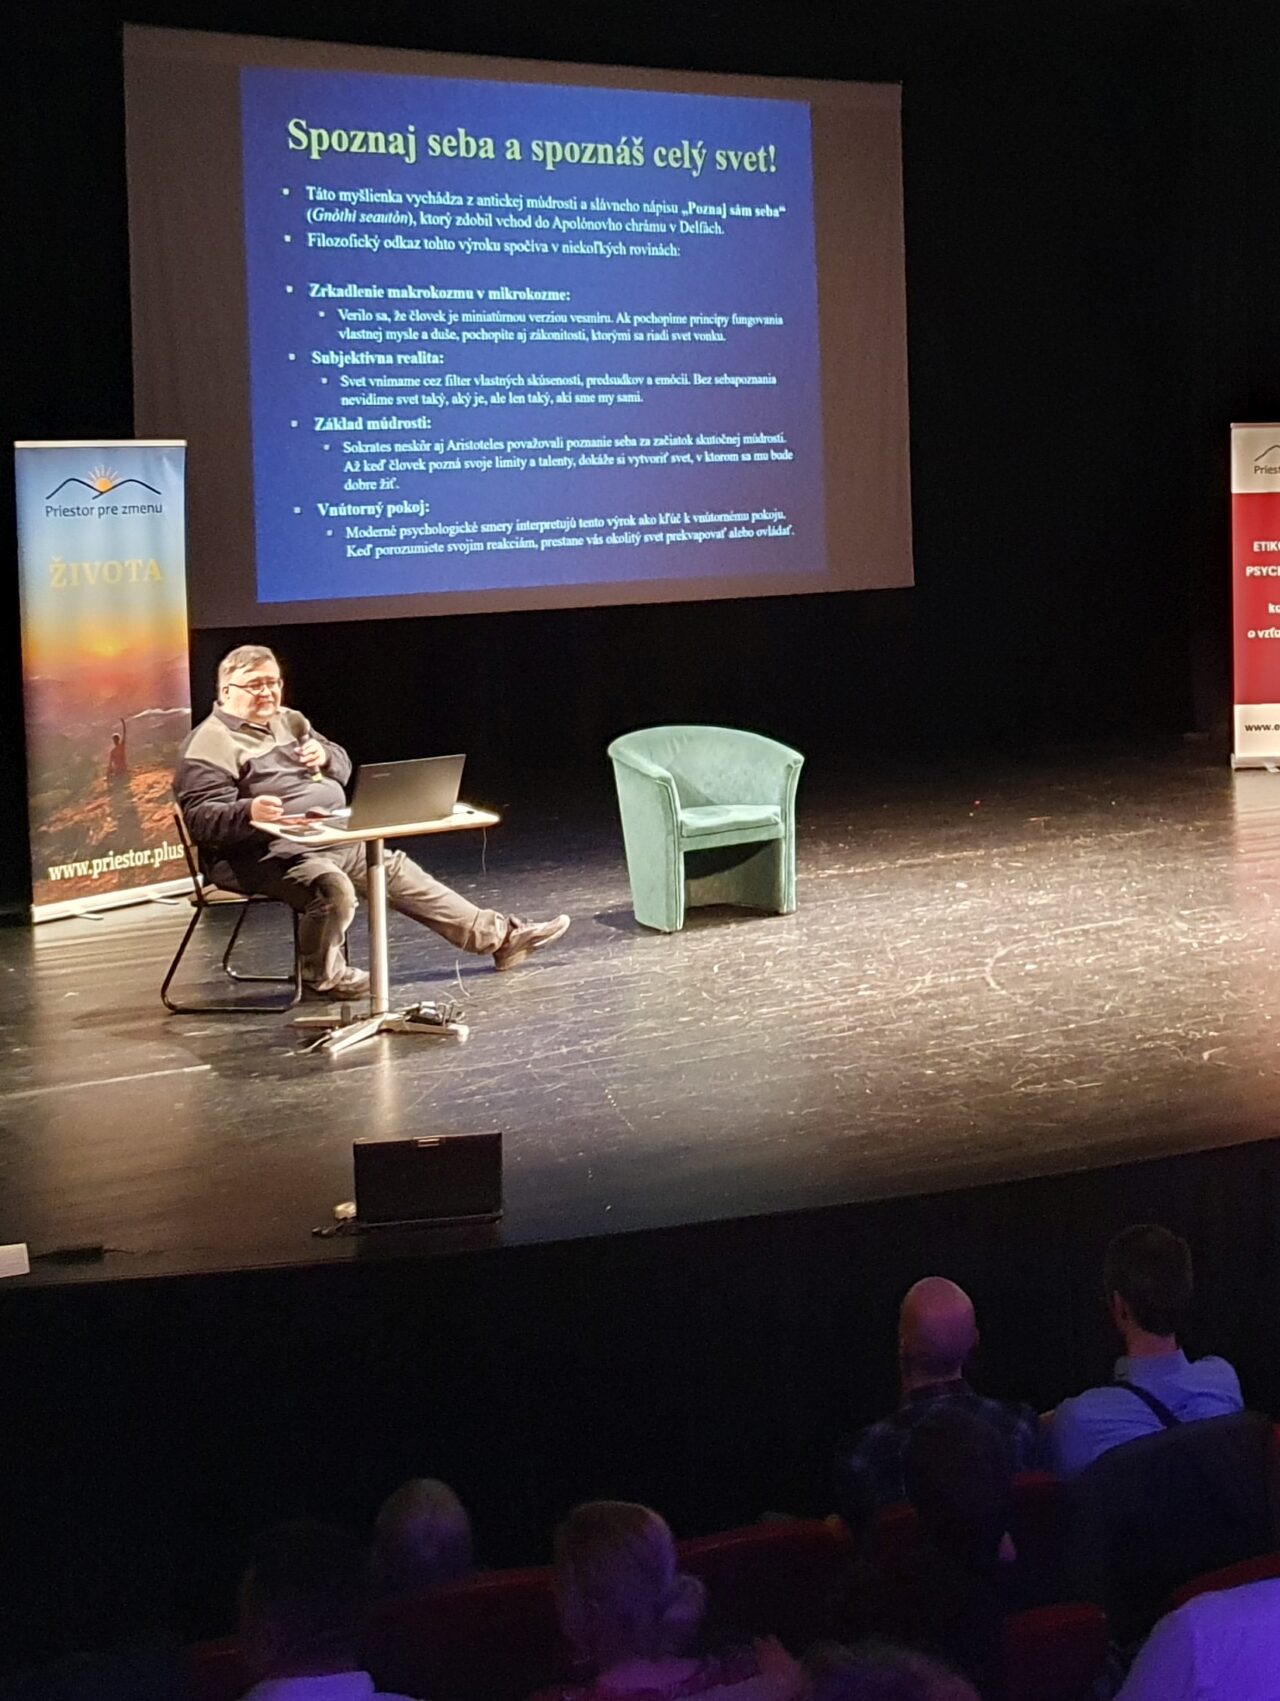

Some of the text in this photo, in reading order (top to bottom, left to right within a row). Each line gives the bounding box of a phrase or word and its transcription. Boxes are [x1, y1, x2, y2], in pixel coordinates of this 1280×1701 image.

[286, 117, 777, 178] Spoznaj seba a spoznáš celý svet!
[304, 184, 336, 201] Táto
[337, 187, 404, 206] myšlienka
[405, 189, 464, 208] vychádza
[466, 195, 474, 206] z
[475, 192, 524, 212] antickej
[525, 194, 578, 210] múdrosti
[579, 200, 588, 210] a
[589, 196, 640, 212] slávneho
[642, 199, 679, 217] nápisu
[728, 203, 753, 217] sám
[418, 210, 452, 230] ktorý
[454, 212, 493, 227] zdobil
[495, 213, 532, 228] vchod
[534, 214, 550, 229] do
[551, 215, 623, 233] Apolónovho
[624, 217, 667, 233] chrámu
[668, 222, 676, 233] v
[678, 219, 725, 235] Delfách.
[306, 231, 681, 258] Filozofický odkaz tohto výroku spočíva v niekoľkých rovinách:
[308, 282, 571, 301] Zrkadlenie makrokozmu v mikrokozme:
[336, 307, 374, 322] Verilo
[393, 309, 407, 322] že
[408, 308, 446, 322] človek
[447, 309, 459, 326] je
[528, 310, 568, 323] verziou
[615, 311, 632, 324] Ak
[337, 326, 383, 343] vlastnej
[384, 326, 420, 343] mysle
[420, 330, 429, 340] a
[516, 327, 527, 344] aj
[590, 328, 632, 344] ktorými
[632, 332, 645, 341] sa
[645, 328, 670, 341] riadi
[670, 330, 692, 341] svet
[310, 349, 444, 368] Subjektívna realita:
[339, 374, 367, 388] Svet
[422, 377, 442, 387] cez
[444, 373, 472, 387] filter
[473, 373, 525, 390] vlastných
[692, 372, 712, 385] Bez
[395, 393, 420, 405] svet
[450, 391, 472, 408] aký
[489, 390, 507, 404] ale
[508, 390, 526, 404] len
[574, 393, 596, 403] sme
[597, 393, 615, 406] my
[313, 416, 364, 431] Základ
[342, 439, 392, 454] Sokrates
[433, 438, 444, 455] aj
[446, 437, 505, 452] Aristoteles
[506, 435, 564, 453] považovali
[565, 434, 613, 452] poznanie
[613, 434, 638, 447] seba
[652, 433, 694, 447] začiatok
[342, 459, 361, 473] Až
[362, 458, 387, 472] keď
[388, 457, 426, 472] človek
[427, 456, 462, 474] pozná
[463, 459, 493, 472] svoje
[494, 455, 528, 471] limity
[615, 452, 626, 465] si
[627, 451, 669, 468] vytvoriť
[342, 477, 378, 491] dobre
[45, 503, 163, 519] Priestor pre zmenu
[316, 498, 430, 518] Vnútorný pokoj:
[480, 522, 514, 535] smery
[578, 517, 605, 529] tento
[606, 513, 637, 530] výrok
[637, 512, 657, 526] ako
[345, 542, 373, 558] Keď
[374, 540, 445, 560] porozumiete
[446, 538, 484, 555] svojim
[540, 536, 584, 551] prestane
[585, 532, 604, 545] vás
[604, 530, 642, 546] okolitý
[642, 531, 664, 543] svet
[664, 526, 727, 545] prekvapovať
[49, 555, 164, 588] ŽIVOTA
[1247, 630, 1256, 638] o
[48, 840, 185, 881] www.priestor.plus
